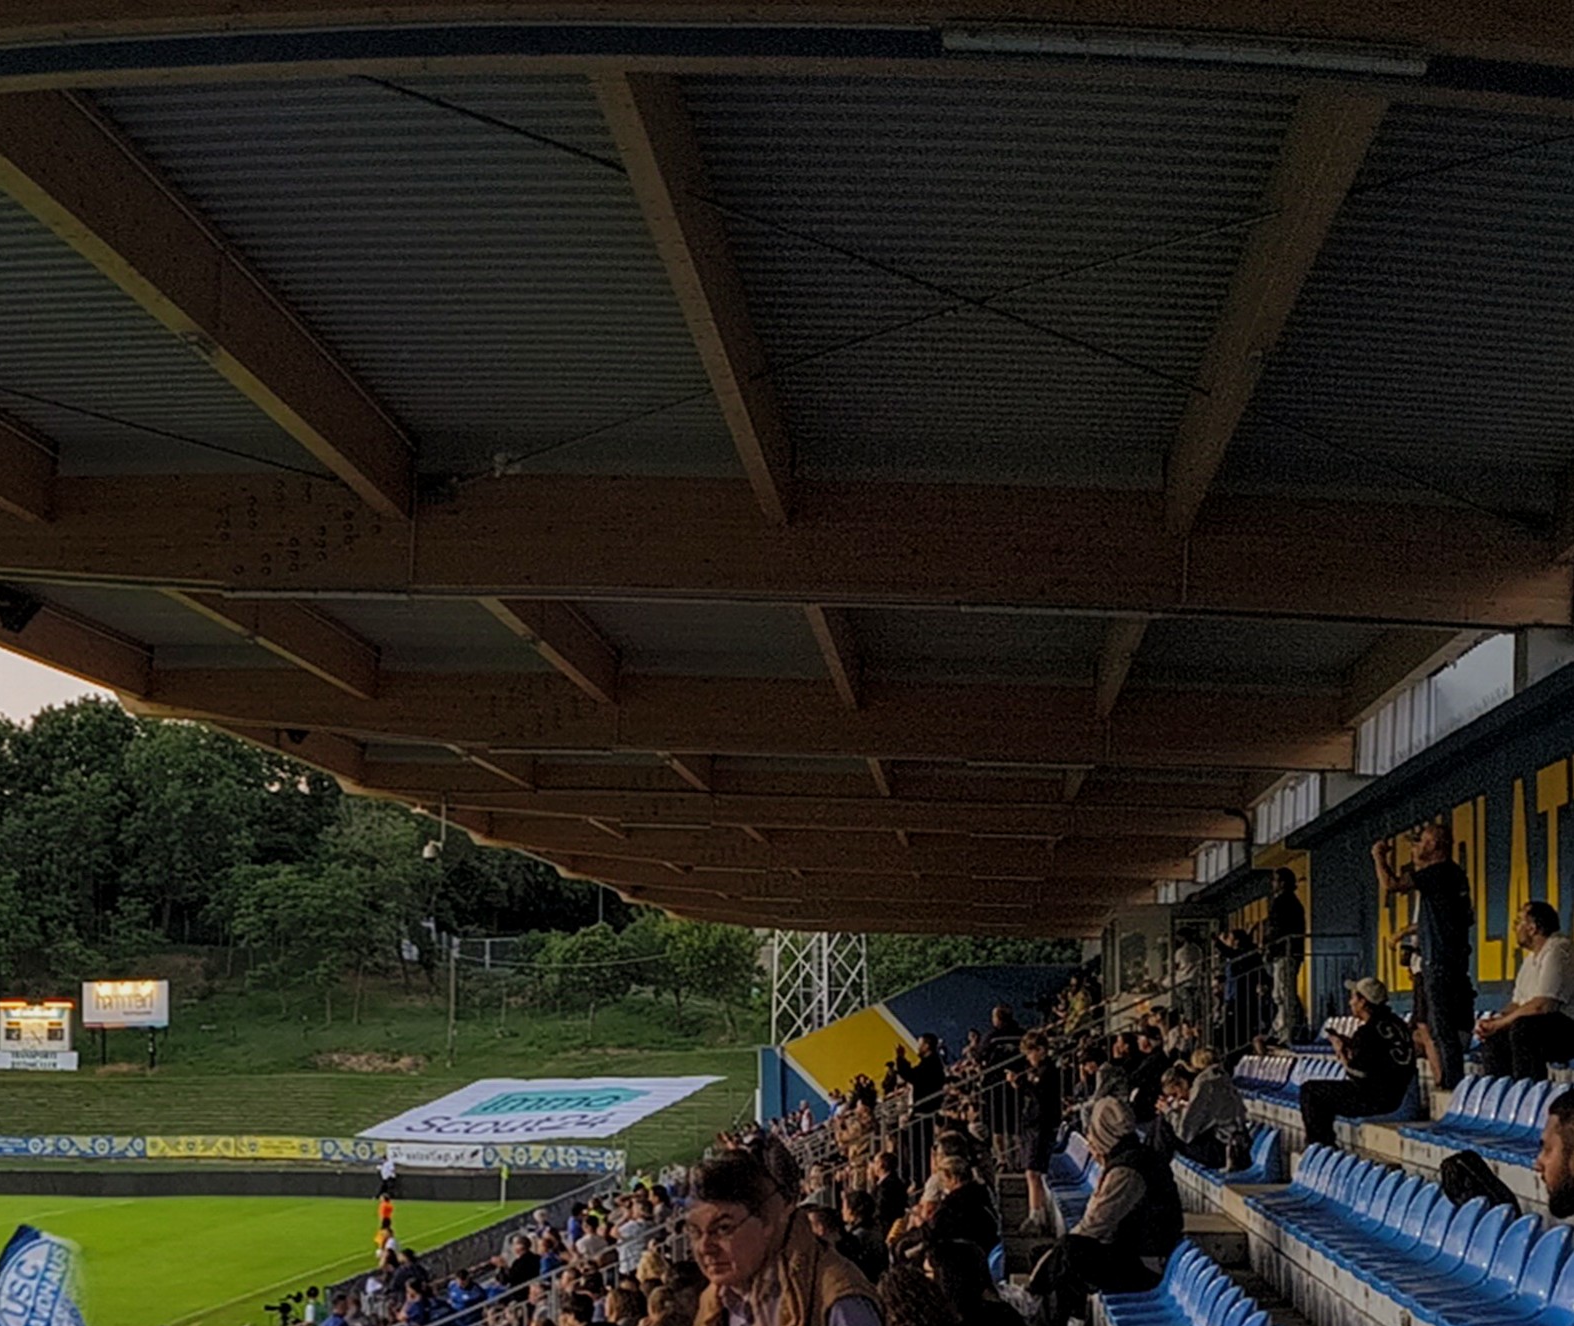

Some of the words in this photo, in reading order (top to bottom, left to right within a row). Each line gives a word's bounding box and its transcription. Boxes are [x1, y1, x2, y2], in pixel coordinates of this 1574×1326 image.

[481, 1091, 620, 1112] Immo
[406, 1111, 613, 1135] Scout24
[1, 1259, 39, 1317] USC
